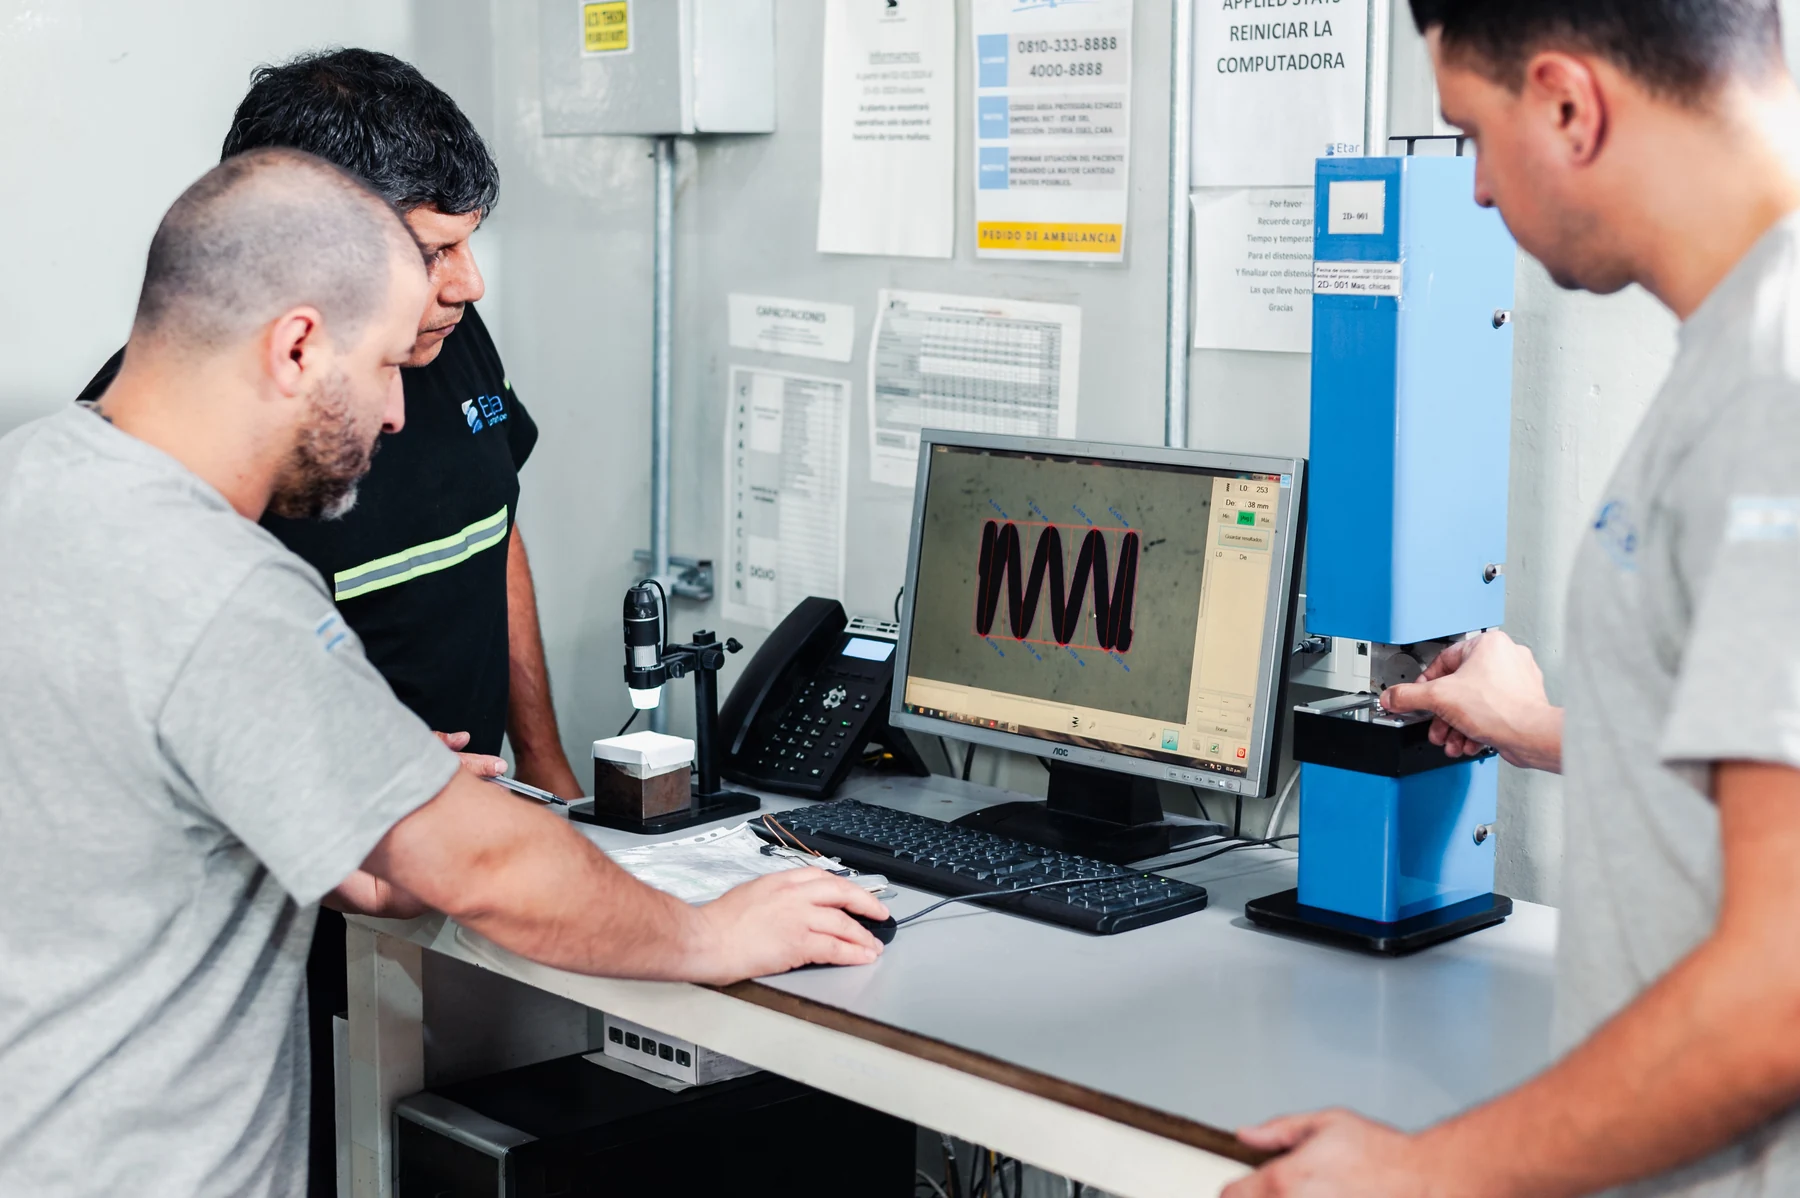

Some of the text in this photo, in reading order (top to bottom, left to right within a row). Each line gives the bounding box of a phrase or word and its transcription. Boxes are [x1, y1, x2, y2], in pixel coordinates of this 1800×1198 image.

[1230, 20, 1333, 42] REINICIAR LA
[1018, 37, 1117, 53] 0810-333-8888
[1217, 52, 1346, 74] COMPUTADORA
[1029, 63, 1104, 78] 4000-8888
[1337, 143, 1360, 154] Etar
[1270, 200, 1303, 208] Por favor
[1258, 217, 1313, 227] Recuerde cargar
[982, 230, 1117, 243] PEDIDO DE AMBULANCIA
[1247, 234, 1314, 244] Tiempo y temperat
[1264, 251, 1271, 259] el
[1272, 252, 1313, 260] distensiona
[1235, 268, 1241, 276] Y
[1241, 268, 1268, 277] finalizar
[1250, 286, 1261, 294] Las
[1262, 287, 1274, 295] que
[1276, 286, 1292, 294] lleve
[1368, 282, 1391, 290] chicas
[1268, 303, 1293, 311] Gracias
[1053, 747, 1069, 757] AOC
